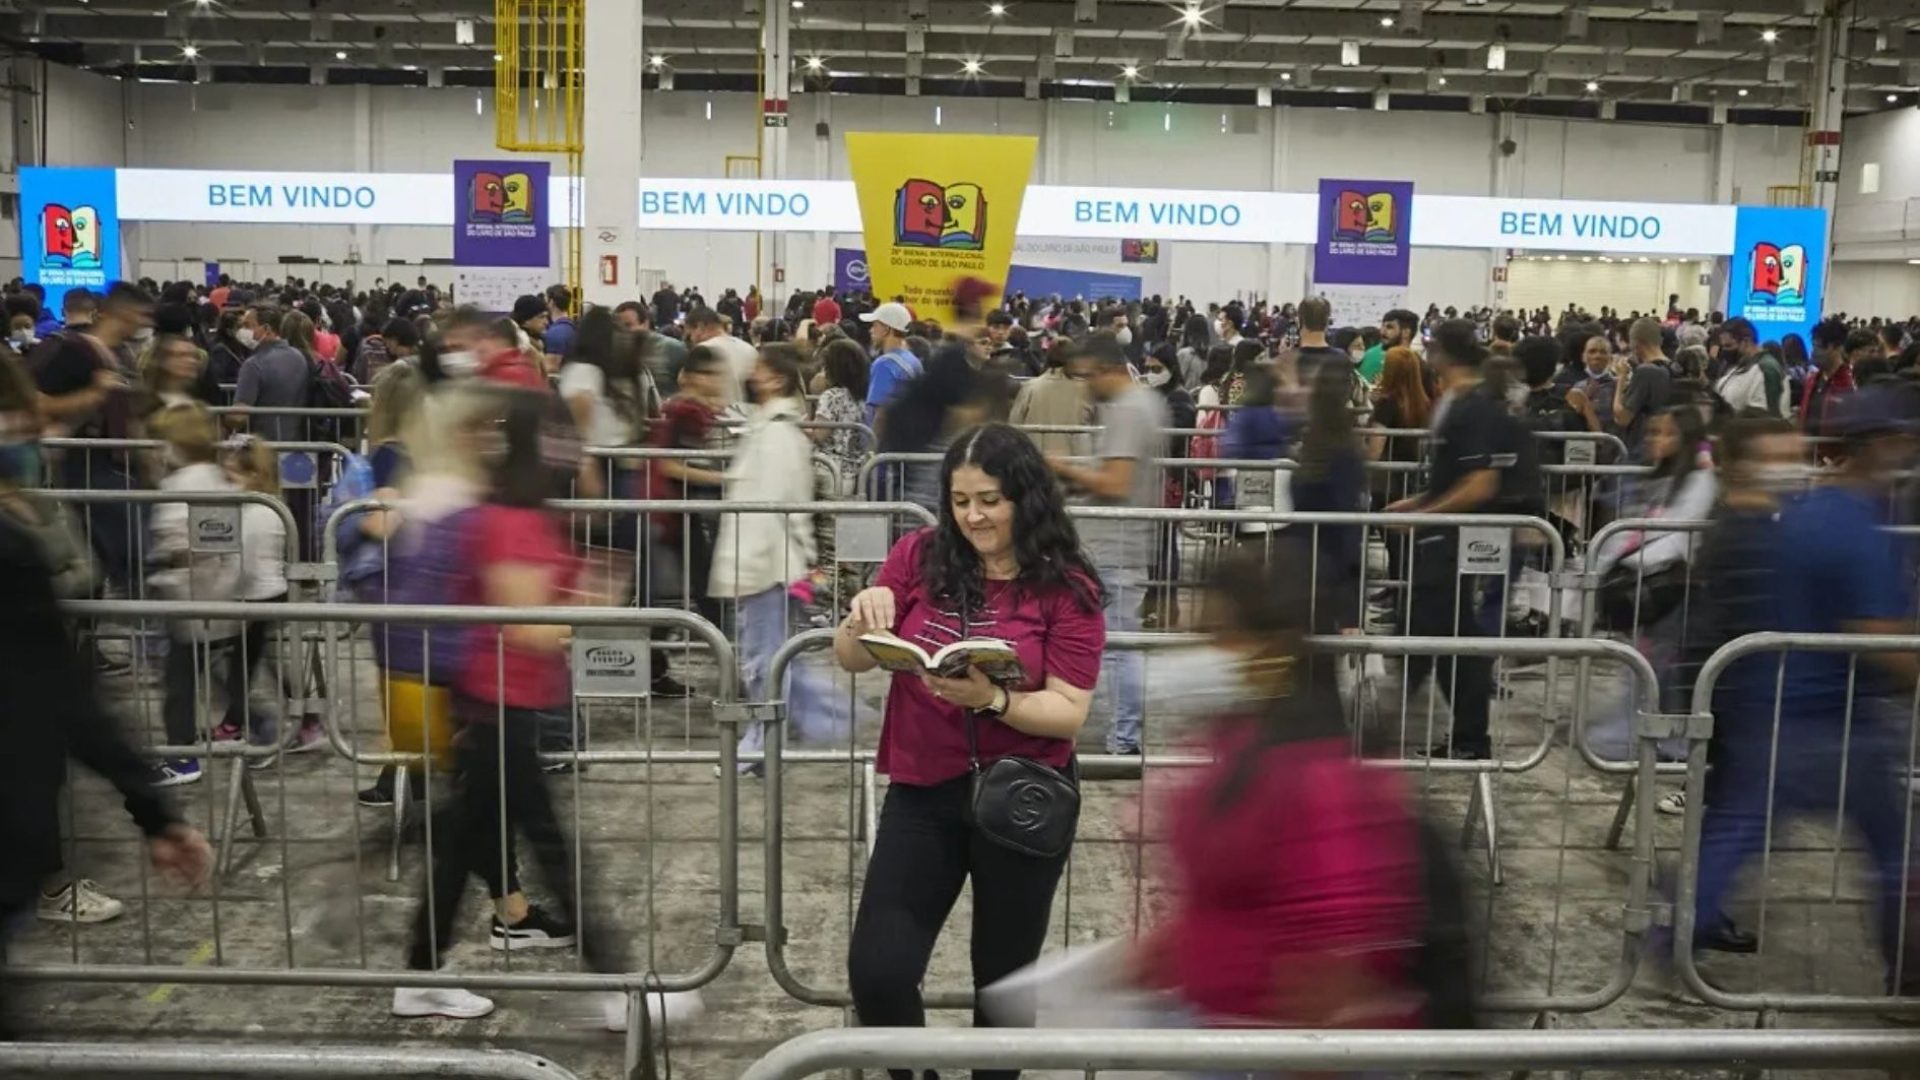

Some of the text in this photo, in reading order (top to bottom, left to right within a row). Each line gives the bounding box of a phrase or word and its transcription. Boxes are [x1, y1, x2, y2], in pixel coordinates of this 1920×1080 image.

[208, 184, 376, 209] BEM VINDO
[642, 191, 810, 216] BEM VINDO
[1075, 200, 1241, 226] BEM VINDO
[1500, 211, 1661, 240] BEM VINDO
[891, 257, 902, 266] DO
[904, 258, 927, 267] LIVRO
[928, 259, 939, 268] DE
[959, 261, 985, 271] PAULO
[903, 249, 928, 257] BIENAL
